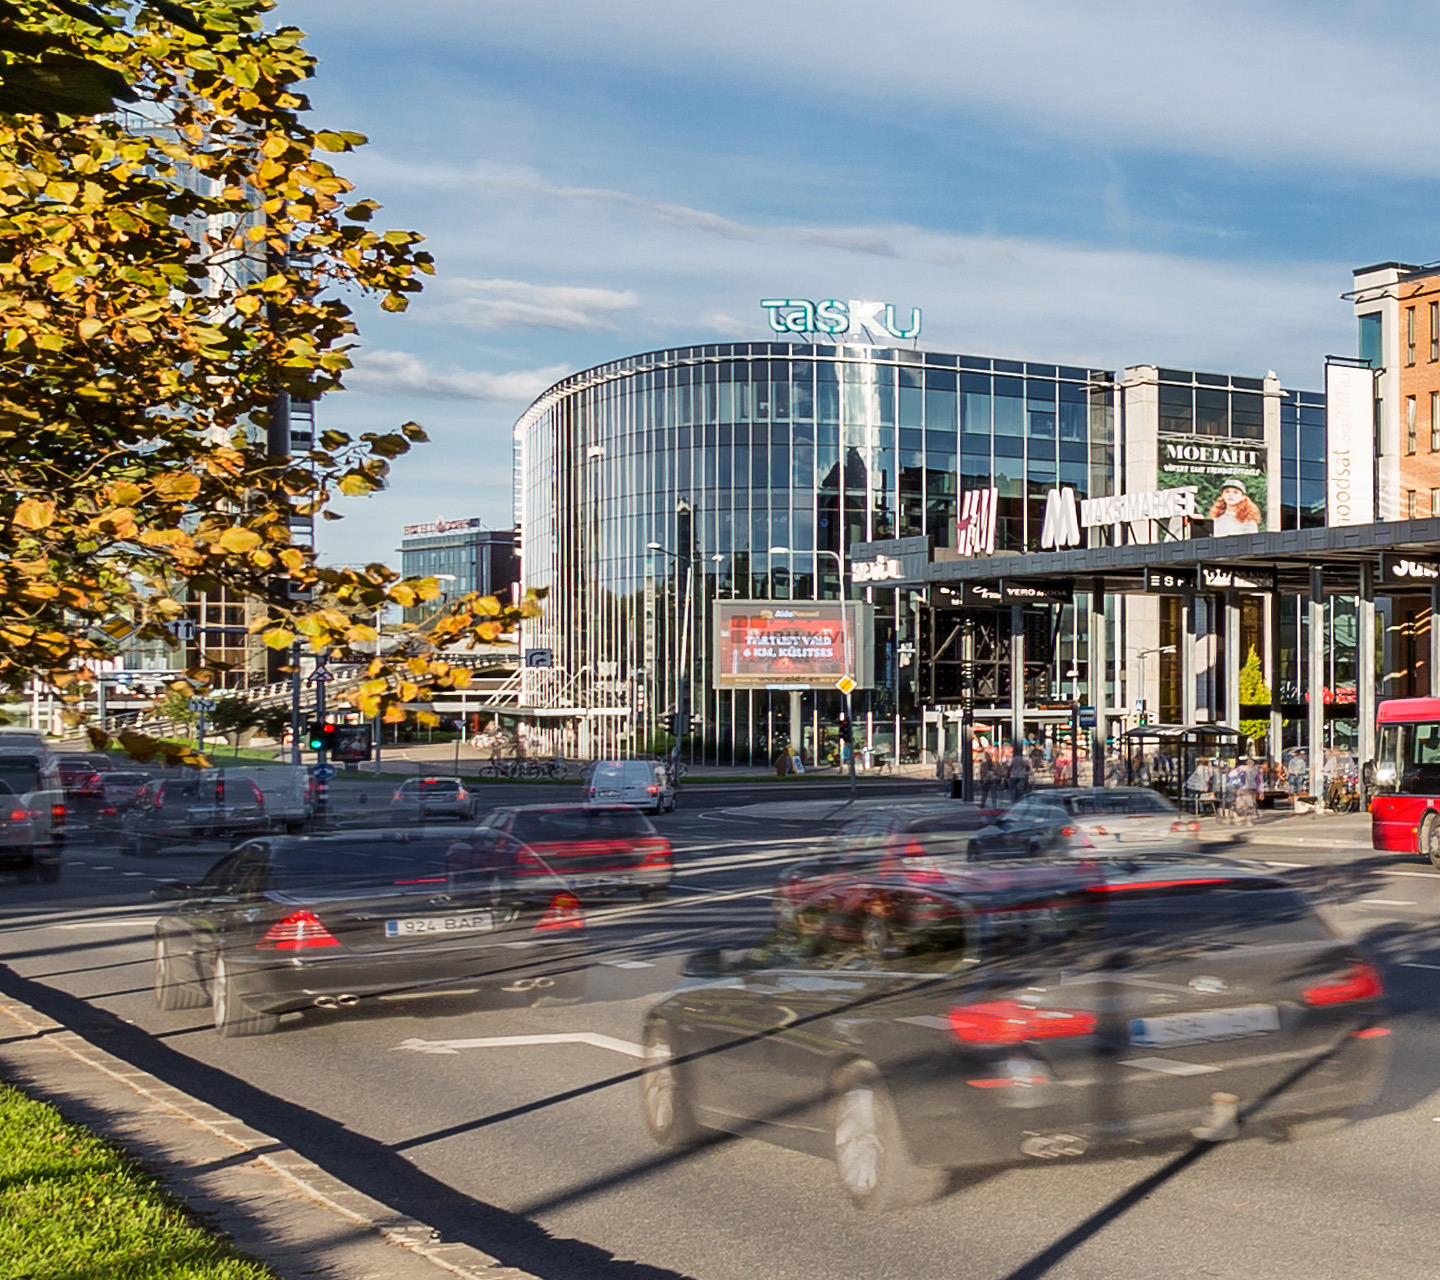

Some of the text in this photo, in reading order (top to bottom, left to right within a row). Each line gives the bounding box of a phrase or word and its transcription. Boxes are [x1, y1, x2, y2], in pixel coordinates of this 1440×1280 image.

[1166, 444, 1260, 465] MOEJAHT
[1080, 485, 1198, 528] MAKSIMARKET
[444, 917, 484, 930] BAP
